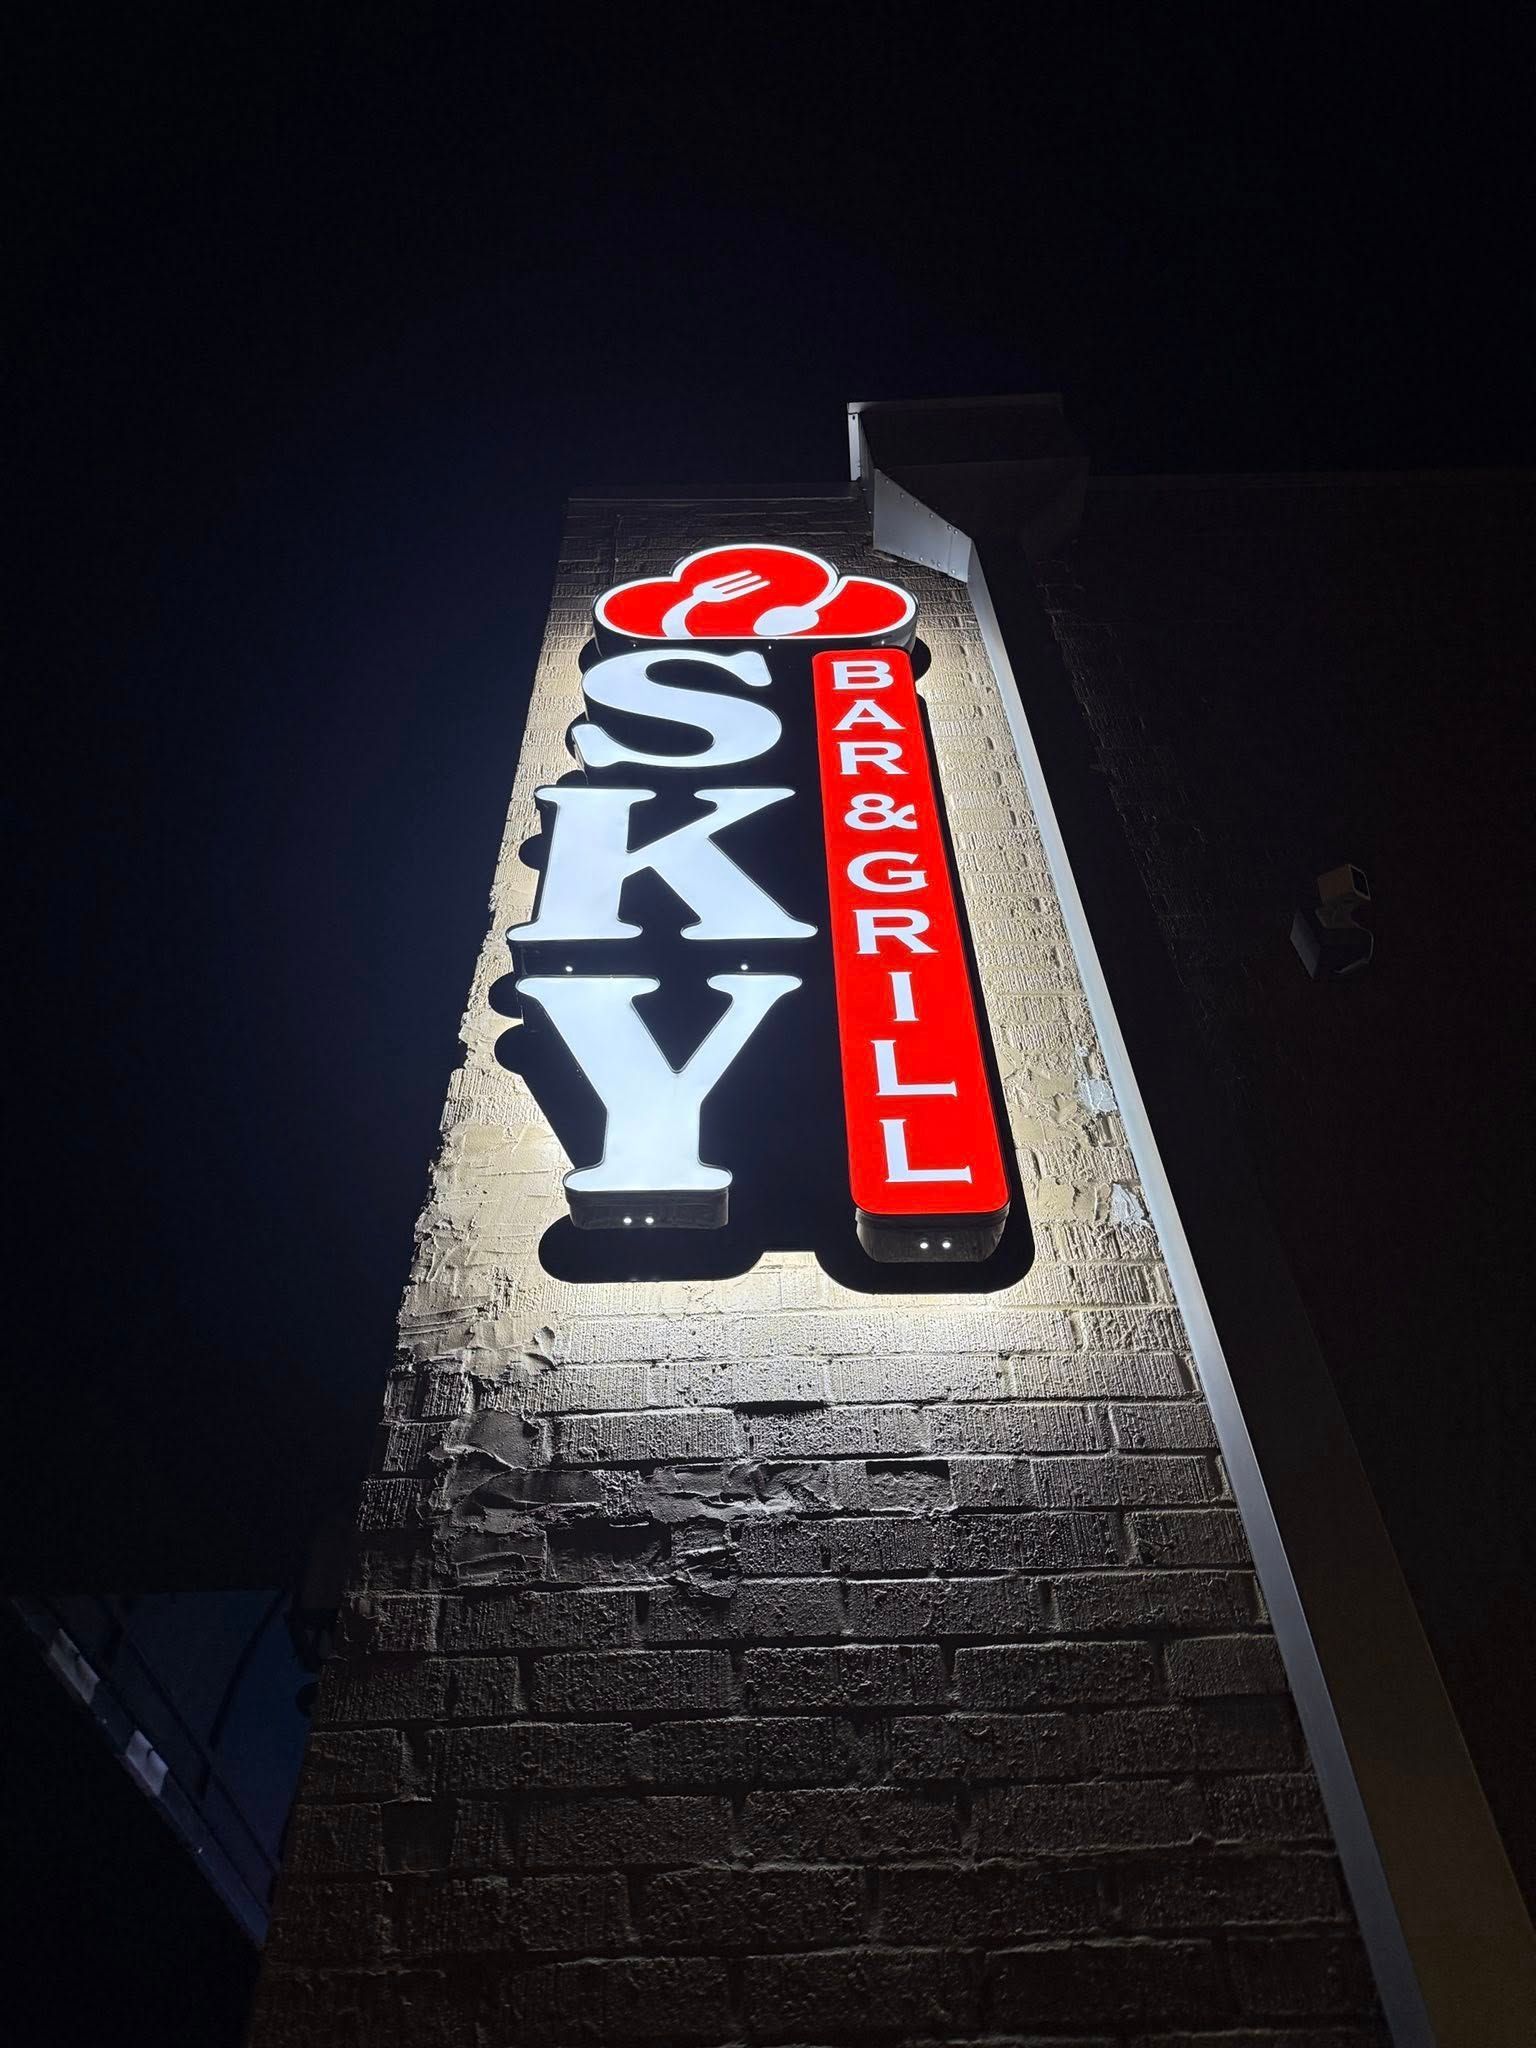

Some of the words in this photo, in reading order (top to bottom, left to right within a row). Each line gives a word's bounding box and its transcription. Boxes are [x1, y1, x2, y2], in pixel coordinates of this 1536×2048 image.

[830, 659, 908, 777] BAR
[505, 647, 821, 1193] SKY
[845, 850, 974, 1186] GRILL
